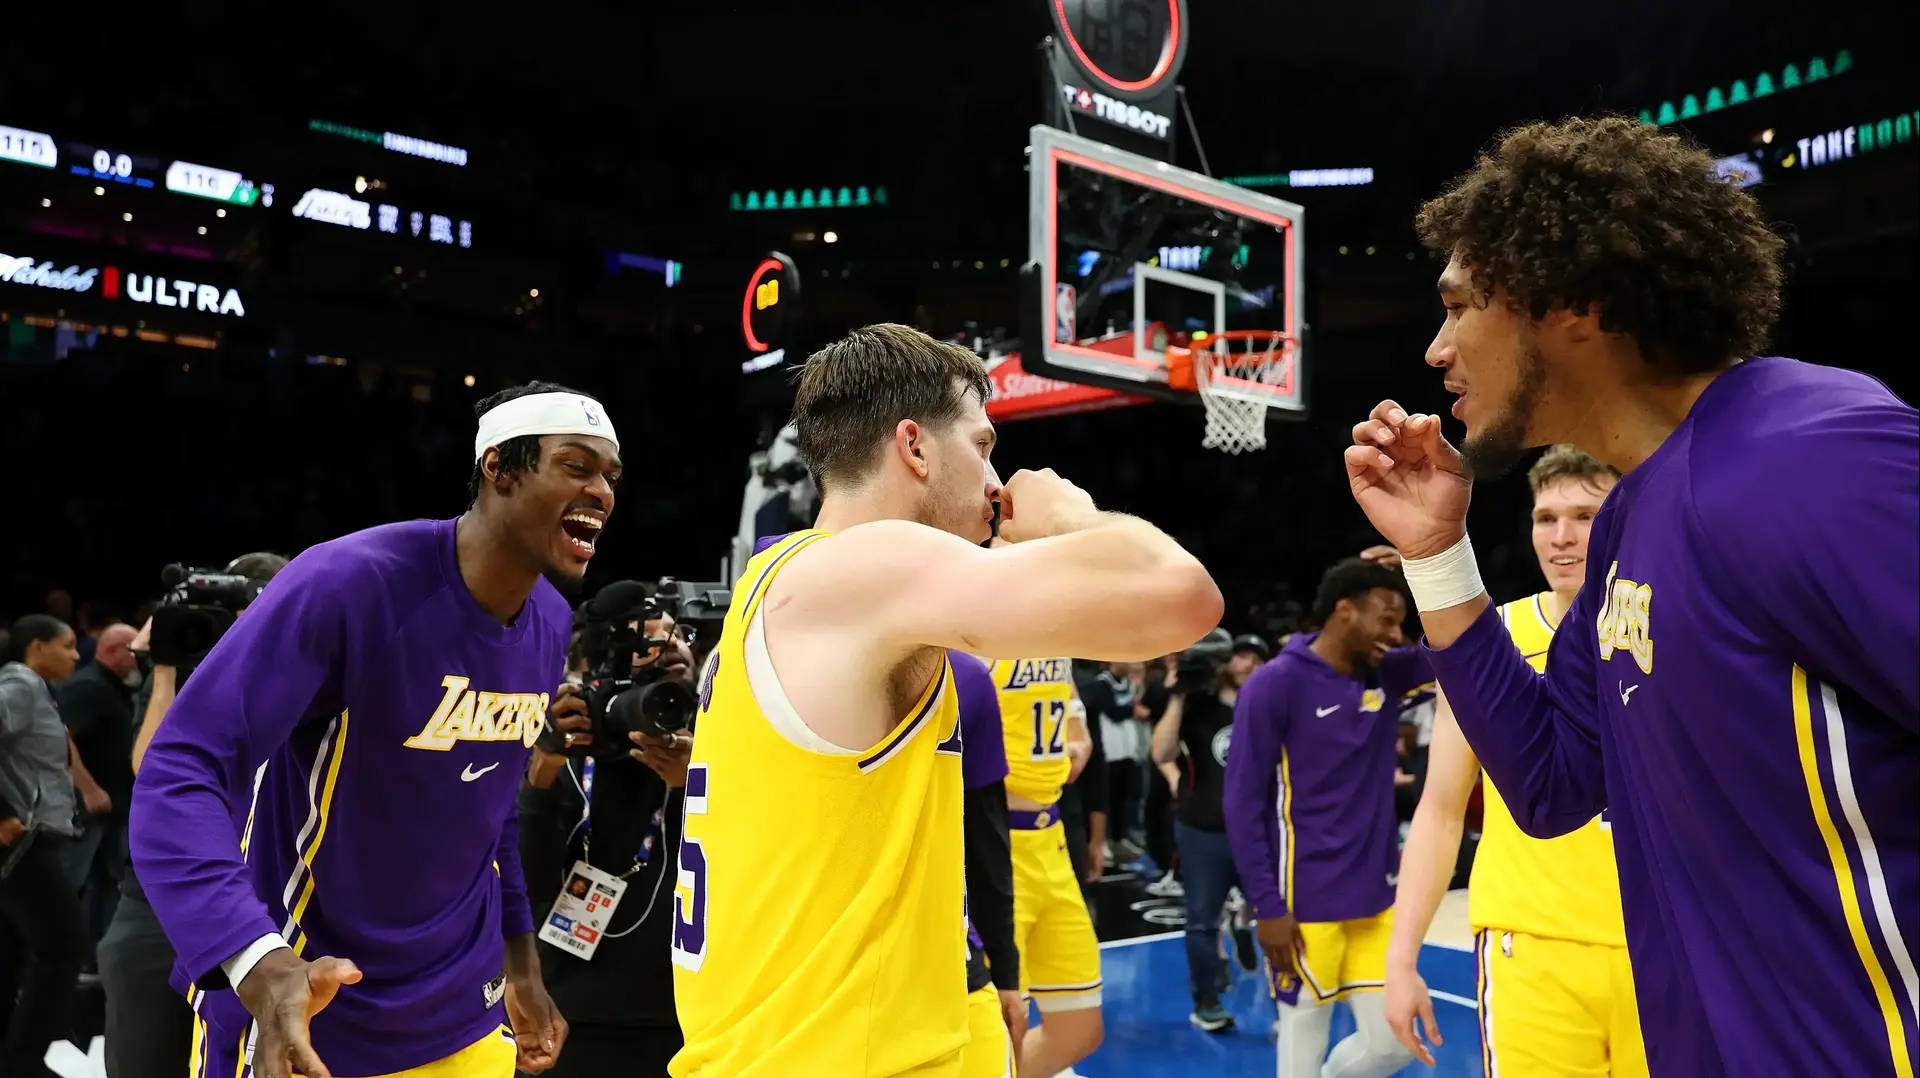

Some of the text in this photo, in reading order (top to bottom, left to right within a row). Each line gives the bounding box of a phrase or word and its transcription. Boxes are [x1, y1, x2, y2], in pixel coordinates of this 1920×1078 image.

[1092, 92, 1171, 138] TISSOT
[93, 149, 133, 178] 0.0
[127, 272, 245, 317] ULTRA
[402, 674, 550, 752] LAKERS
[1030, 699, 1066, 762] 12
